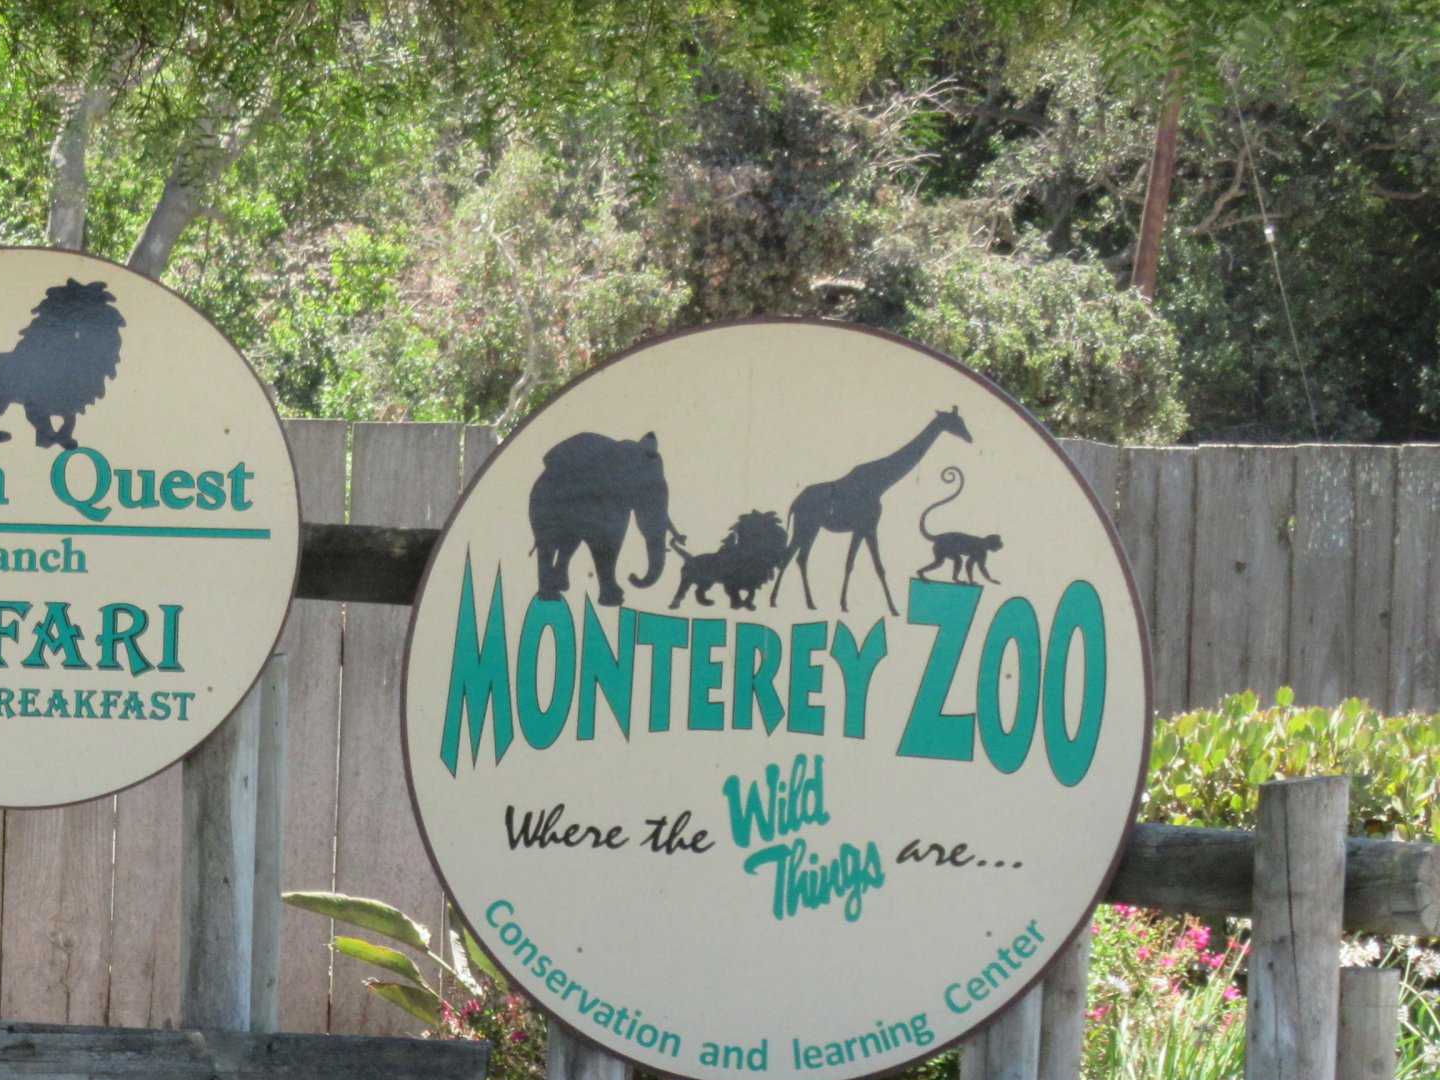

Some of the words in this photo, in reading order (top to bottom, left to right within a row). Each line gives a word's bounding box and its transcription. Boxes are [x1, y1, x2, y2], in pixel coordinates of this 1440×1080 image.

[50, 447, 255, 522] Quest
[439, 541, 888, 779] MONTEREY
[895, 577, 1107, 788] ZOO
[505, 803, 629, 852] Where
[640, 810, 716, 856] the
[723, 753, 830, 849] Wild
[745, 841, 886, 923] Things
[484, 899, 681, 1059] Conservation
[699, 1038, 768, 1072] and
[792, 1012, 935, 1072] learning
[944, 919, 1048, 1016] Center
